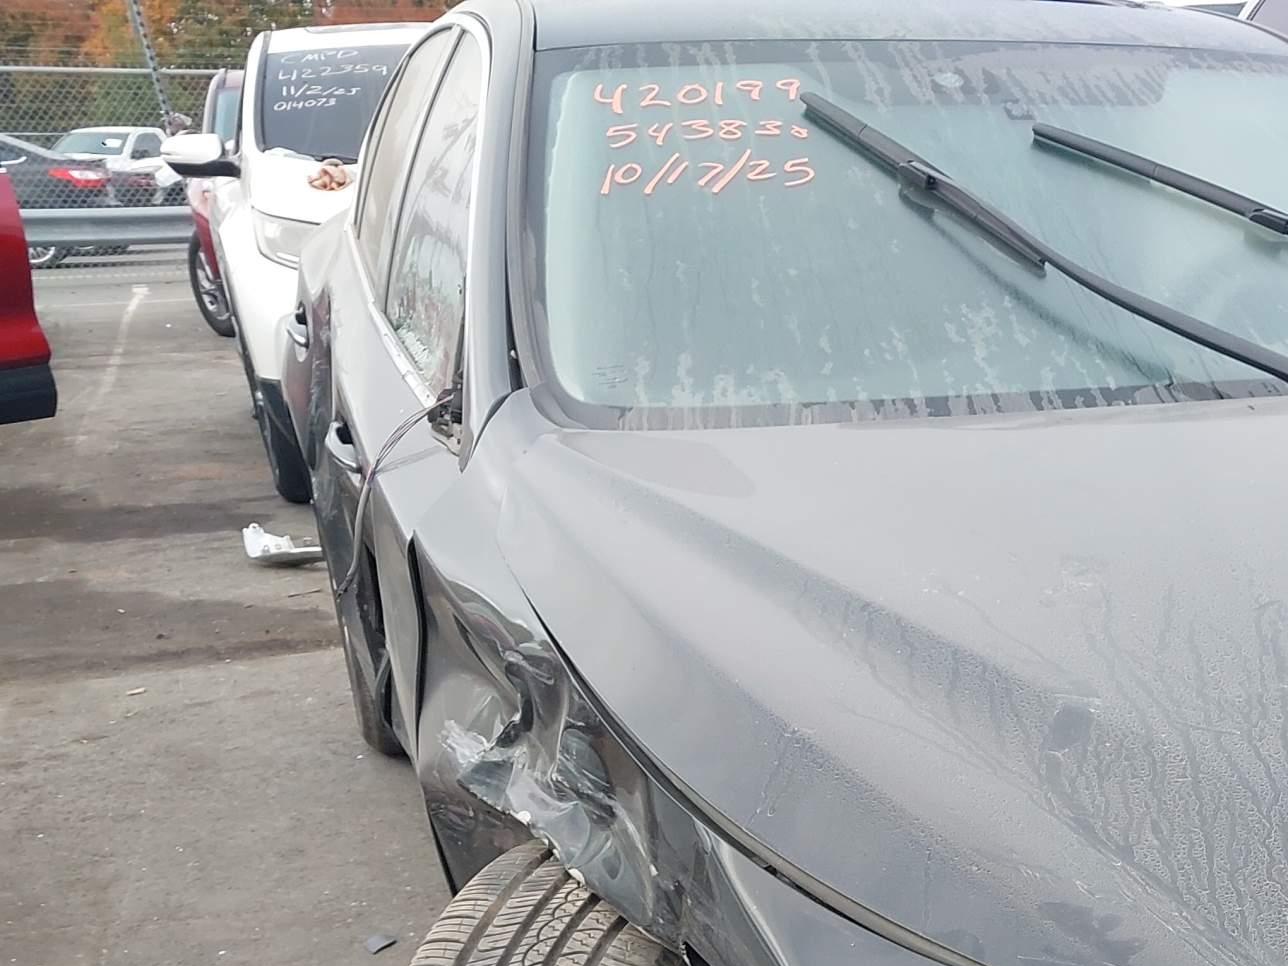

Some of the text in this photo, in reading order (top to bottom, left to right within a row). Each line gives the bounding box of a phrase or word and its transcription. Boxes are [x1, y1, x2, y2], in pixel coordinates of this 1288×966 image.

[282, 84, 361, 97] 11/2/25
[593, 79, 800, 114] 420199
[600, 149, 816, 194] 10/17/25
